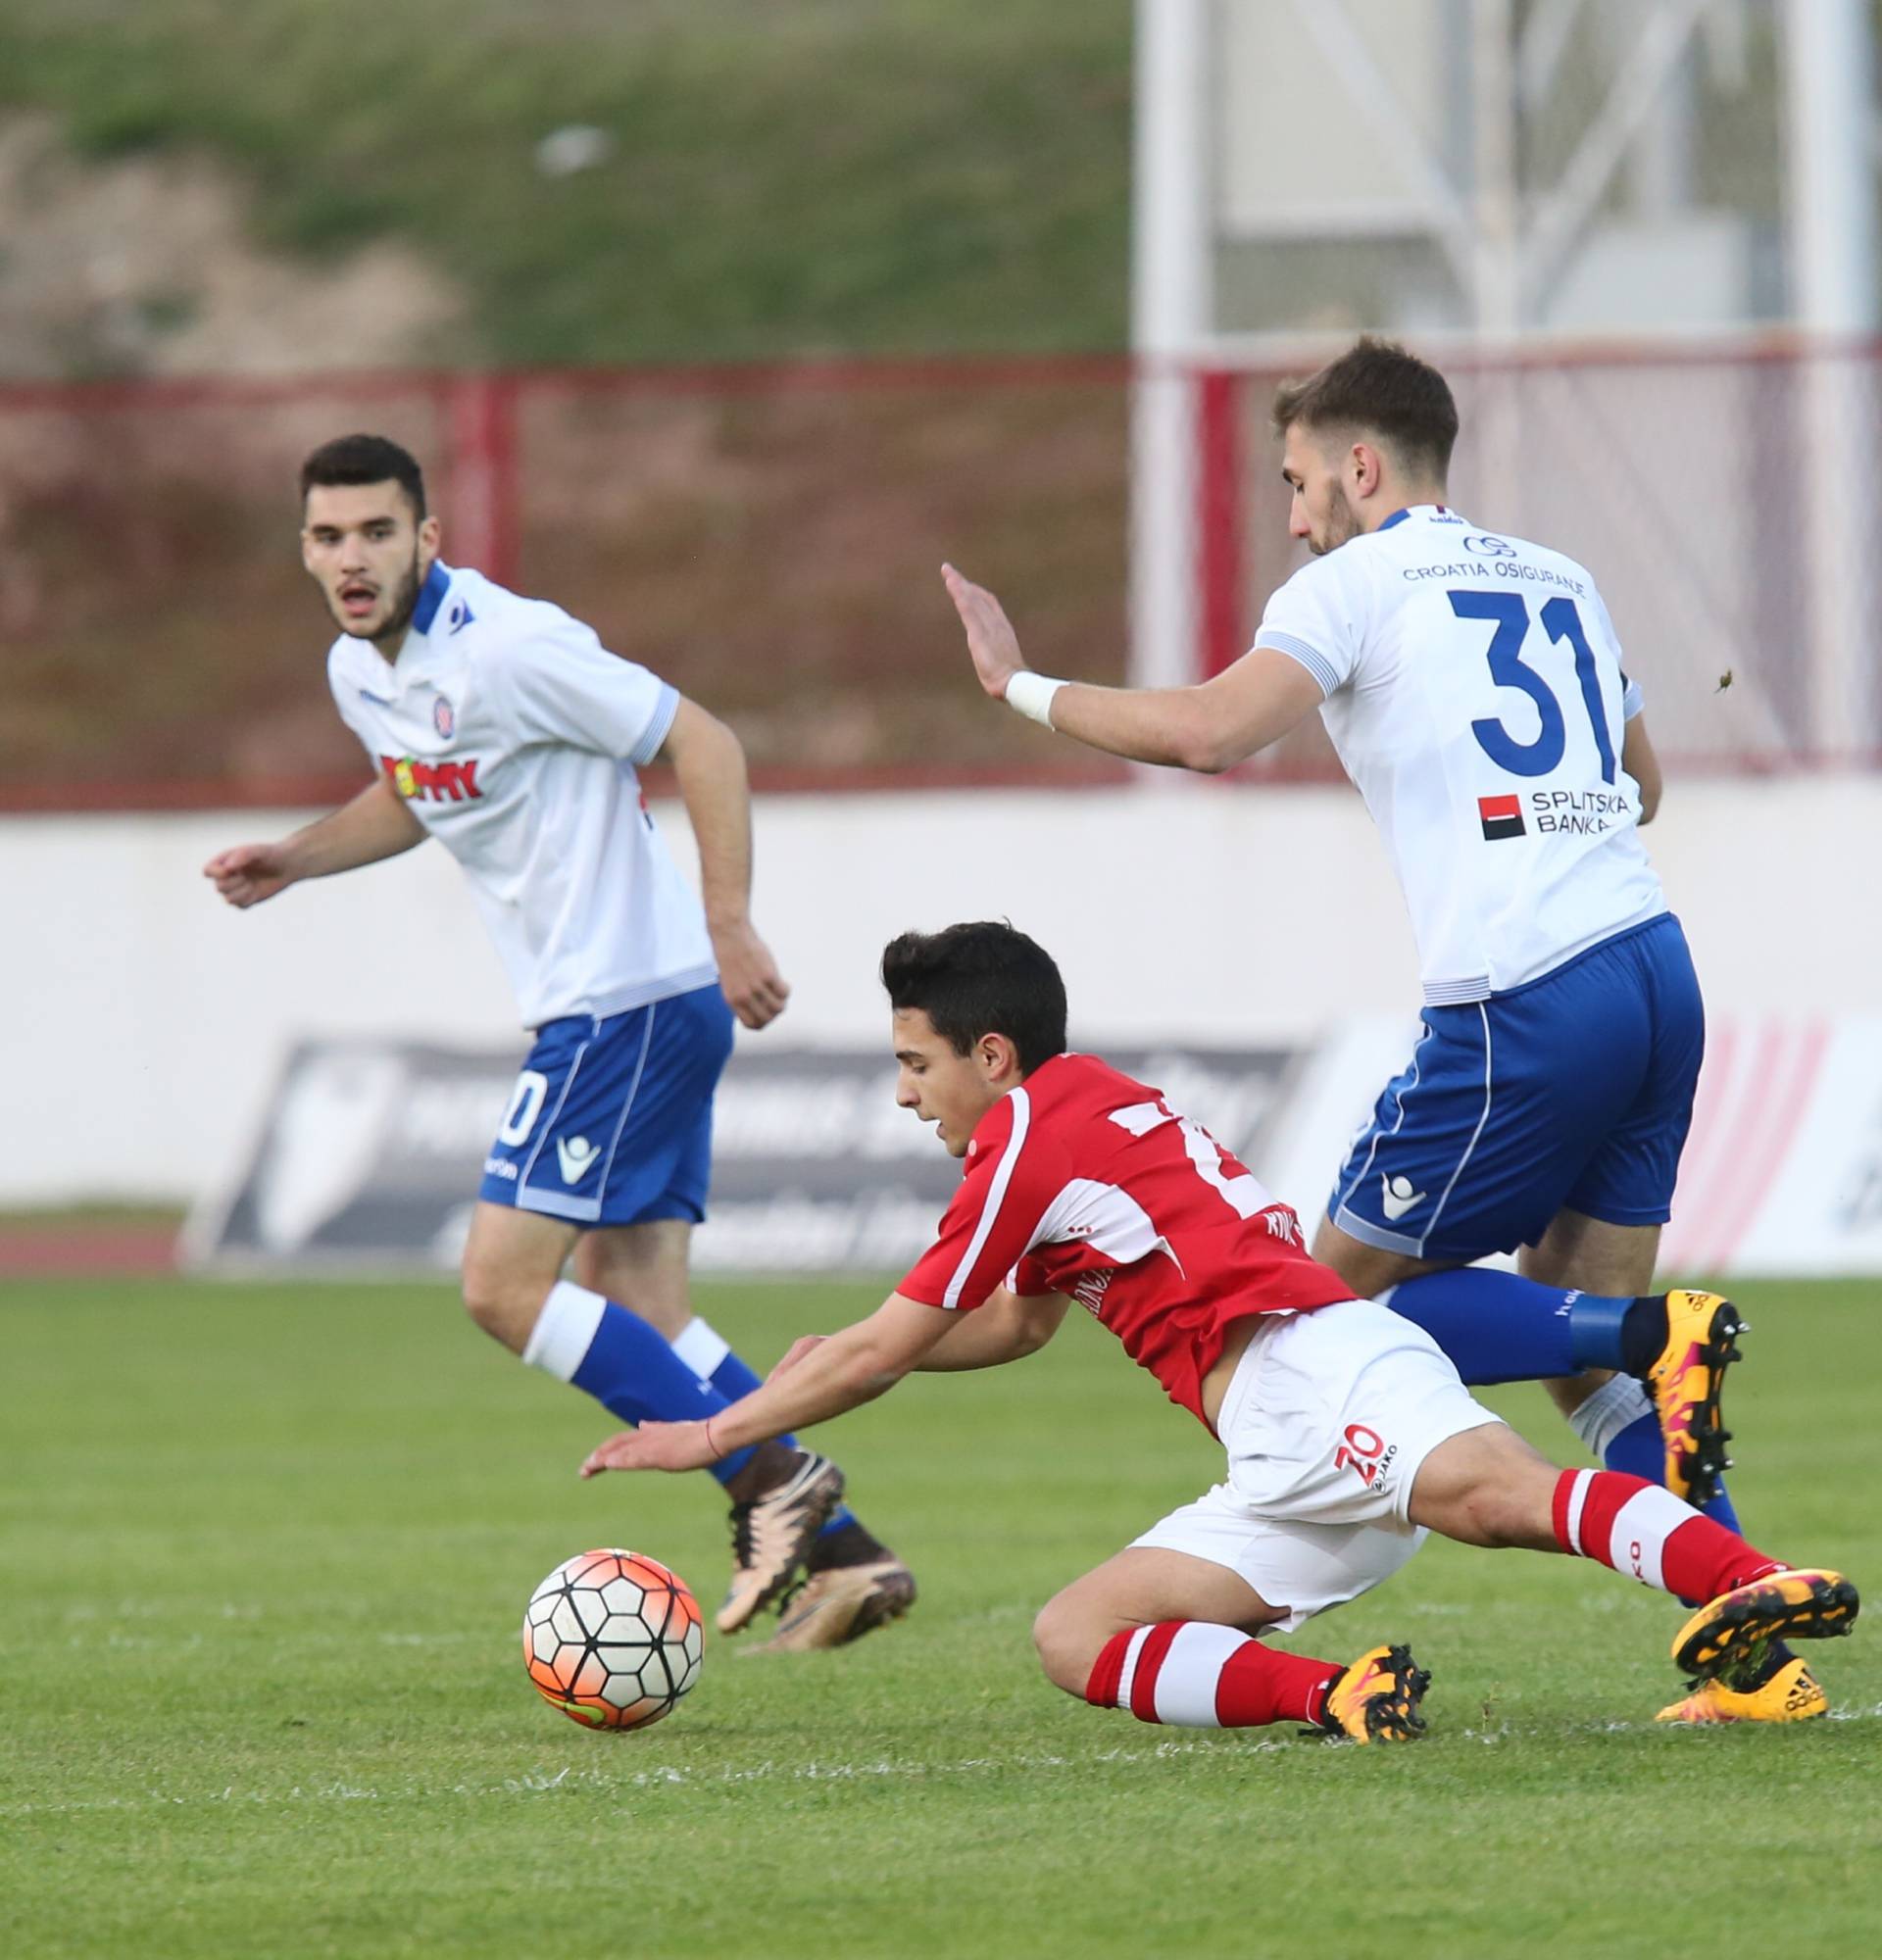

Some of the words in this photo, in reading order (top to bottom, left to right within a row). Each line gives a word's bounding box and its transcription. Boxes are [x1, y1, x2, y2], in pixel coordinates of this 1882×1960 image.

[1403, 562, 1489, 581] CROATIA
[1446, 590, 1616, 786] 31
[1532, 791, 1632, 814] SPLITSKA
[1537, 813, 1615, 835] BANKA
[1334, 1424, 1384, 1488] 20
[1378, 1445, 1398, 1480] JAKO
